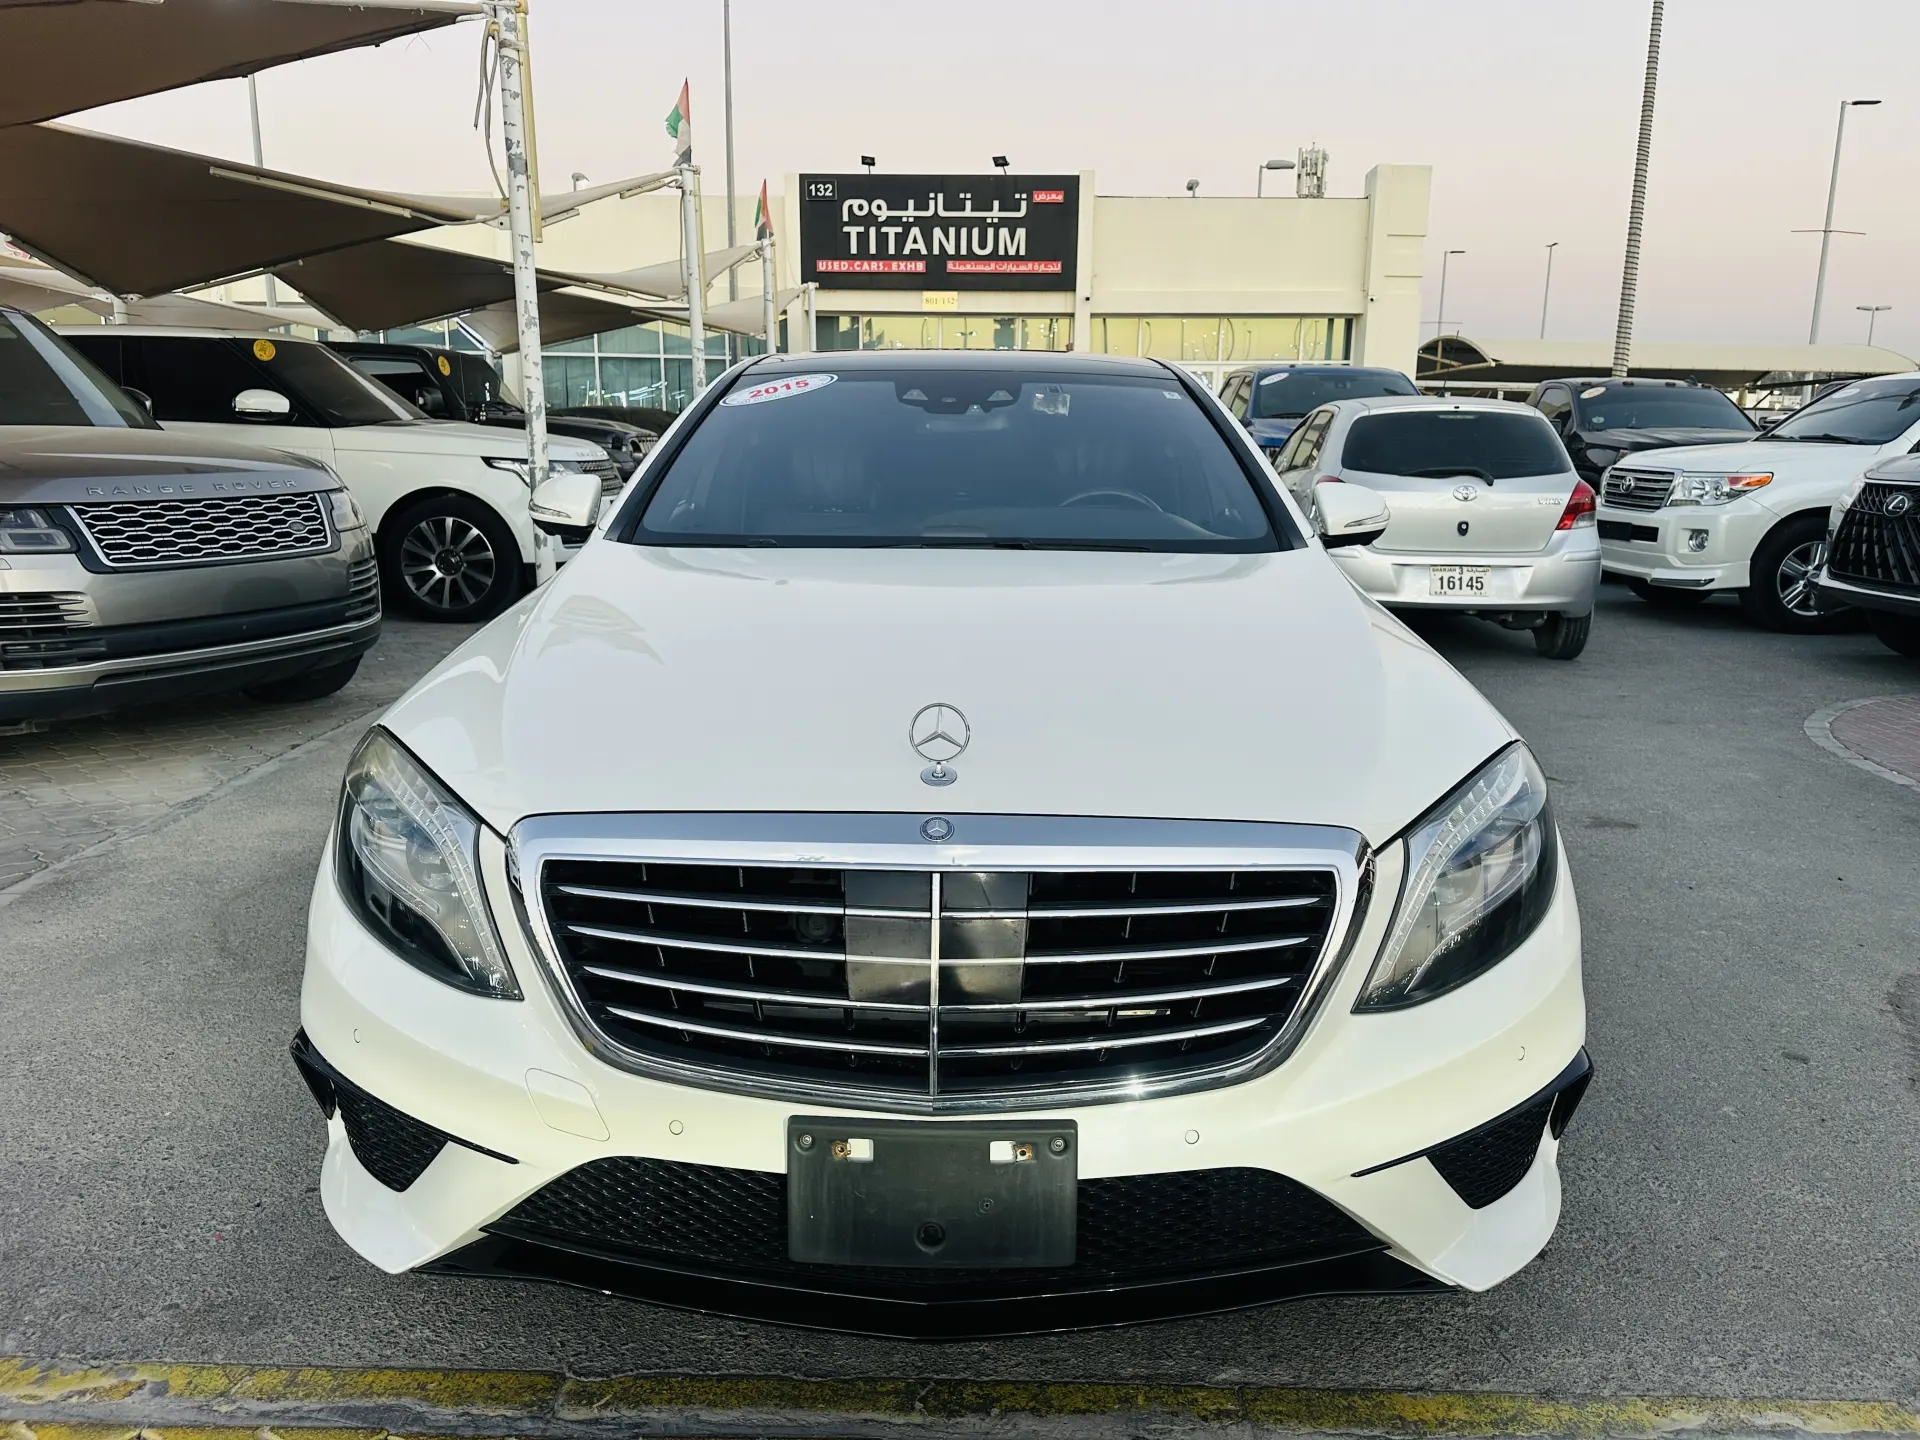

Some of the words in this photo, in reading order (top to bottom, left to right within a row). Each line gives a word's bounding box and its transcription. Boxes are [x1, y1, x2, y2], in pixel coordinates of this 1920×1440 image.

[809, 184, 833, 197] 132
[1034, 193, 1063, 201] معرض
[842, 192, 1027, 222] تيتانيوم
[843, 226, 1026, 255] TITANIUM
[891, 261, 924, 272] EXHB
[947, 262, 995, 271] المستعملة
[996, 262, 1032, 272] السيارات
[1034, 262, 1061, 272] لتجارة
[749, 379, 809, 398] 2015
[85, 483, 195, 496] RANGE
[213, 478, 298, 492] ROVER
[1458, 566, 1464, 575] 3
[1438, 575, 1484, 591] 16145
